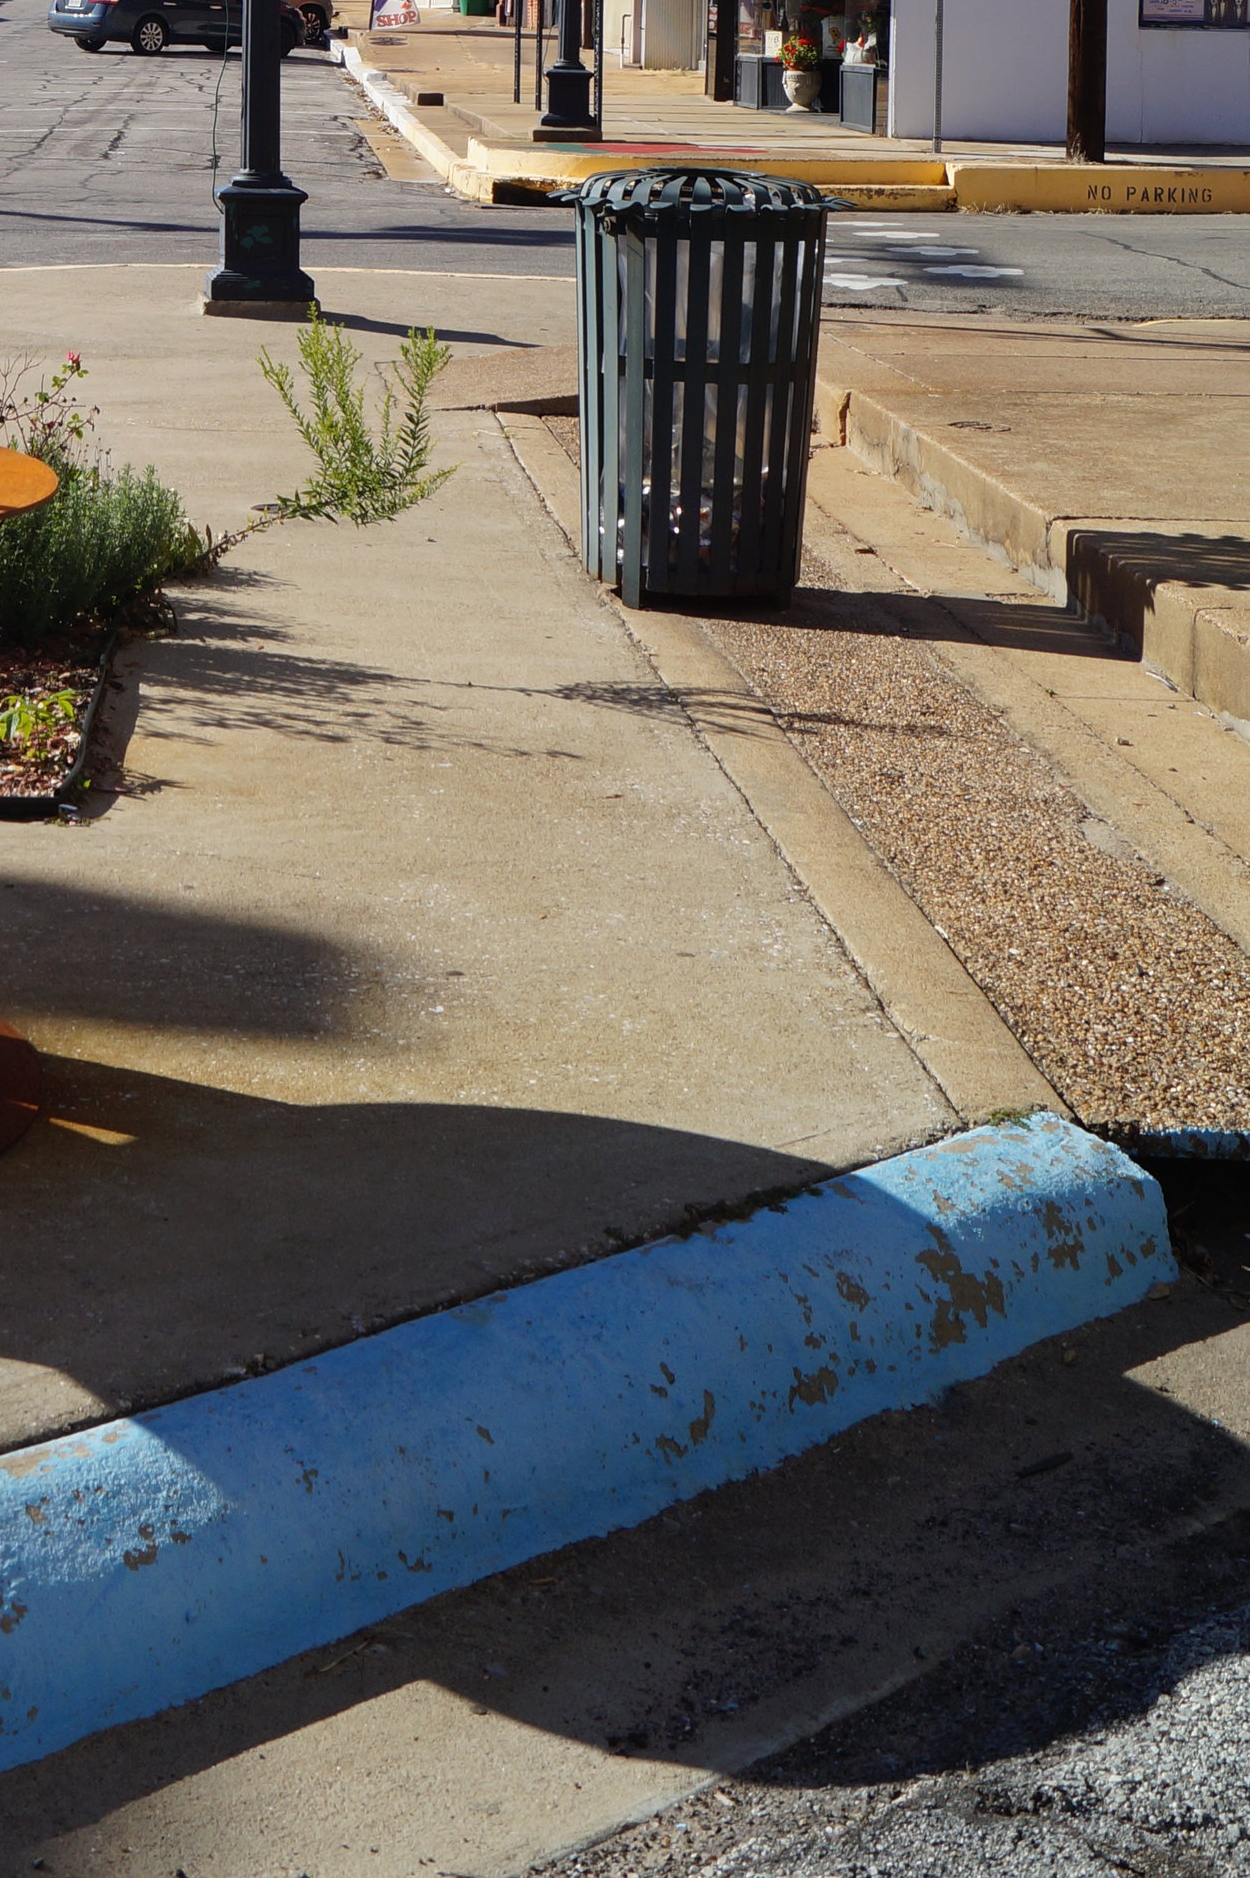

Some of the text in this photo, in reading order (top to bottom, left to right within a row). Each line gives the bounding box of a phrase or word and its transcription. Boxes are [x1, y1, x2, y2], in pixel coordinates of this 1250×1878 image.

[376, 10, 417, 28] SHOP
[1087, 185, 1213, 203] NO PARKING
